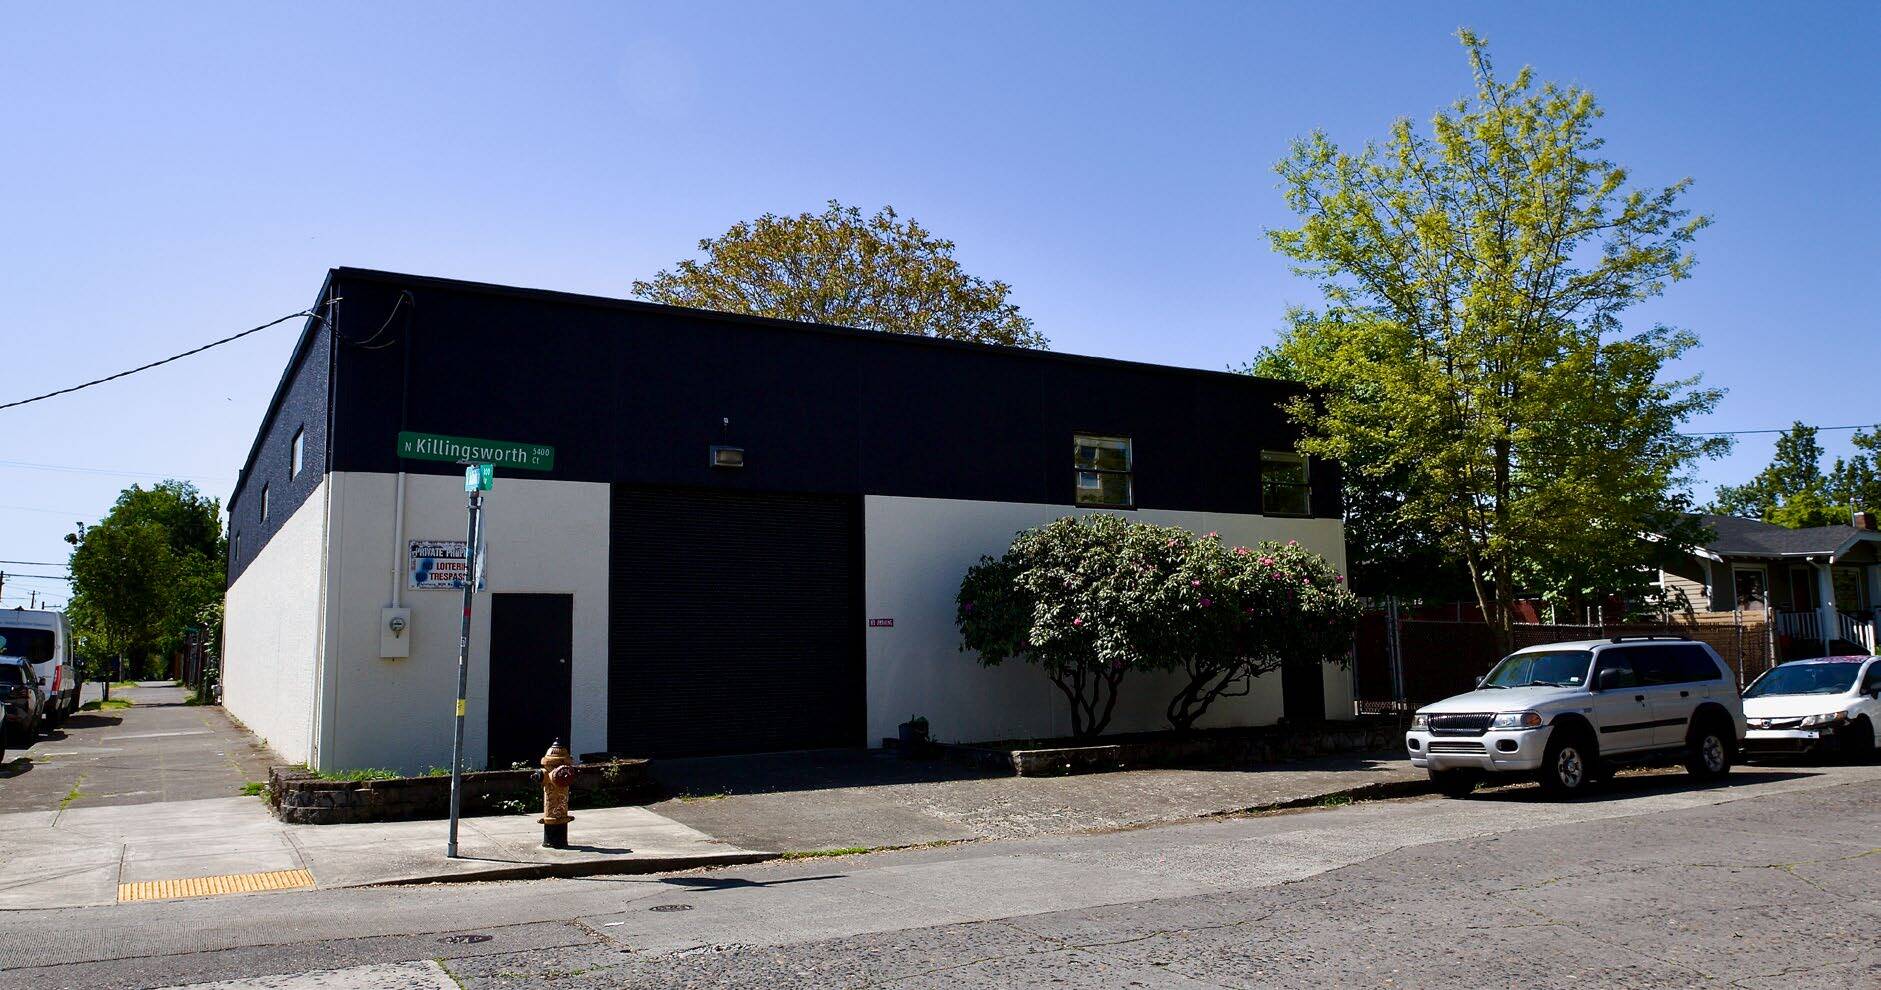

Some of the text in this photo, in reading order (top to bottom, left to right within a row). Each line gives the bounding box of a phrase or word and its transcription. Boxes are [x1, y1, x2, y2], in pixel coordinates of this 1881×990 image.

[405, 438, 527, 462] N Killingsworth
[533, 448, 550, 457] 5400
[532, 457, 540, 465] Ct
[415, 547, 444, 557] PRIVATE
